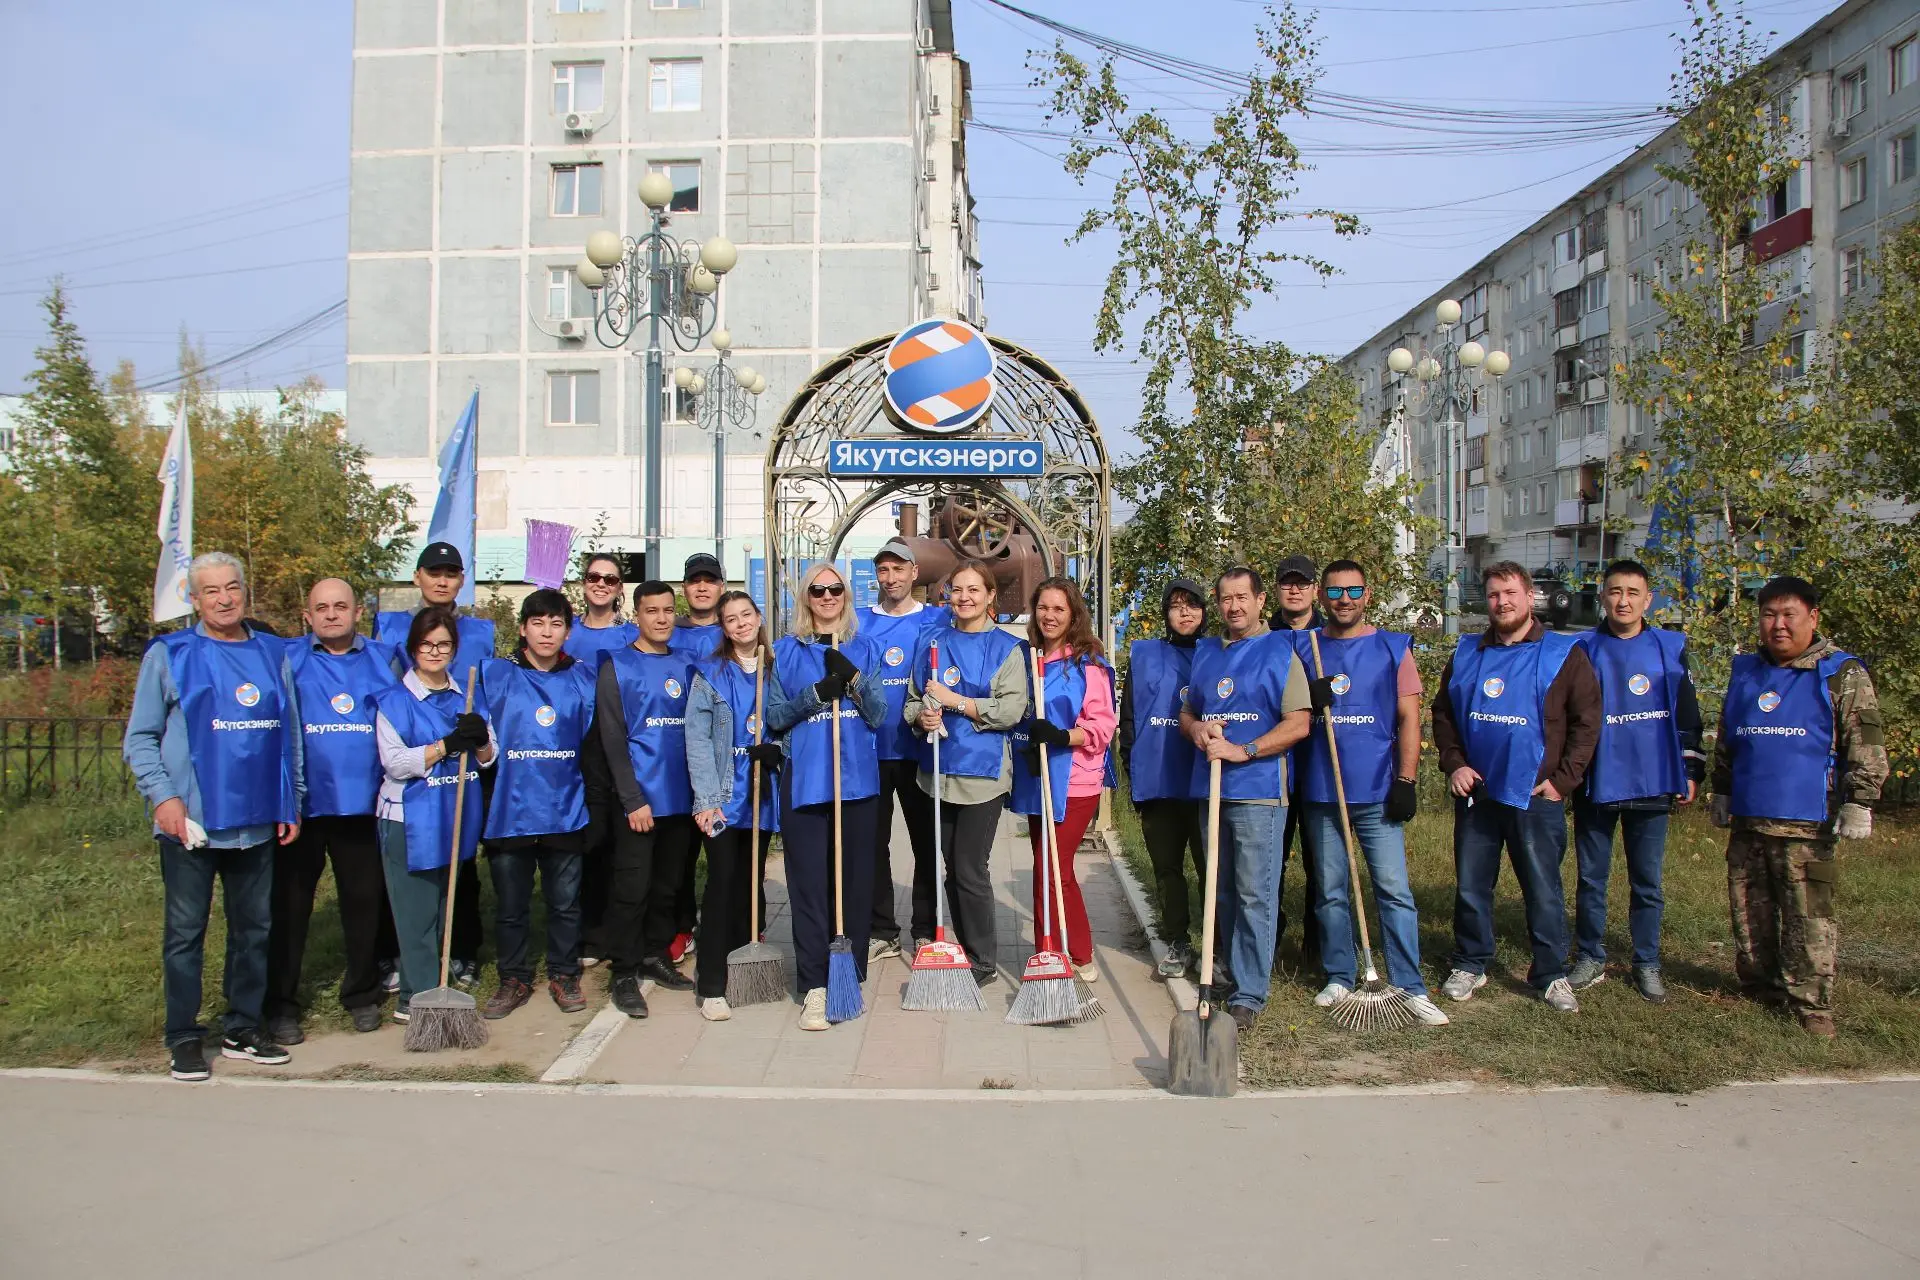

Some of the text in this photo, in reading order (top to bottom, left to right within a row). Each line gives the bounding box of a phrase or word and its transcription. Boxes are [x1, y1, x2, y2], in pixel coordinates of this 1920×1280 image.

[836, 443, 1037, 471] Якутскэнерго
[1606, 709, 1670, 725] Якутскэнерго
[1736, 726, 1806, 738] Якутскэнерго
[507, 750, 575, 760] Якутскэнерго
